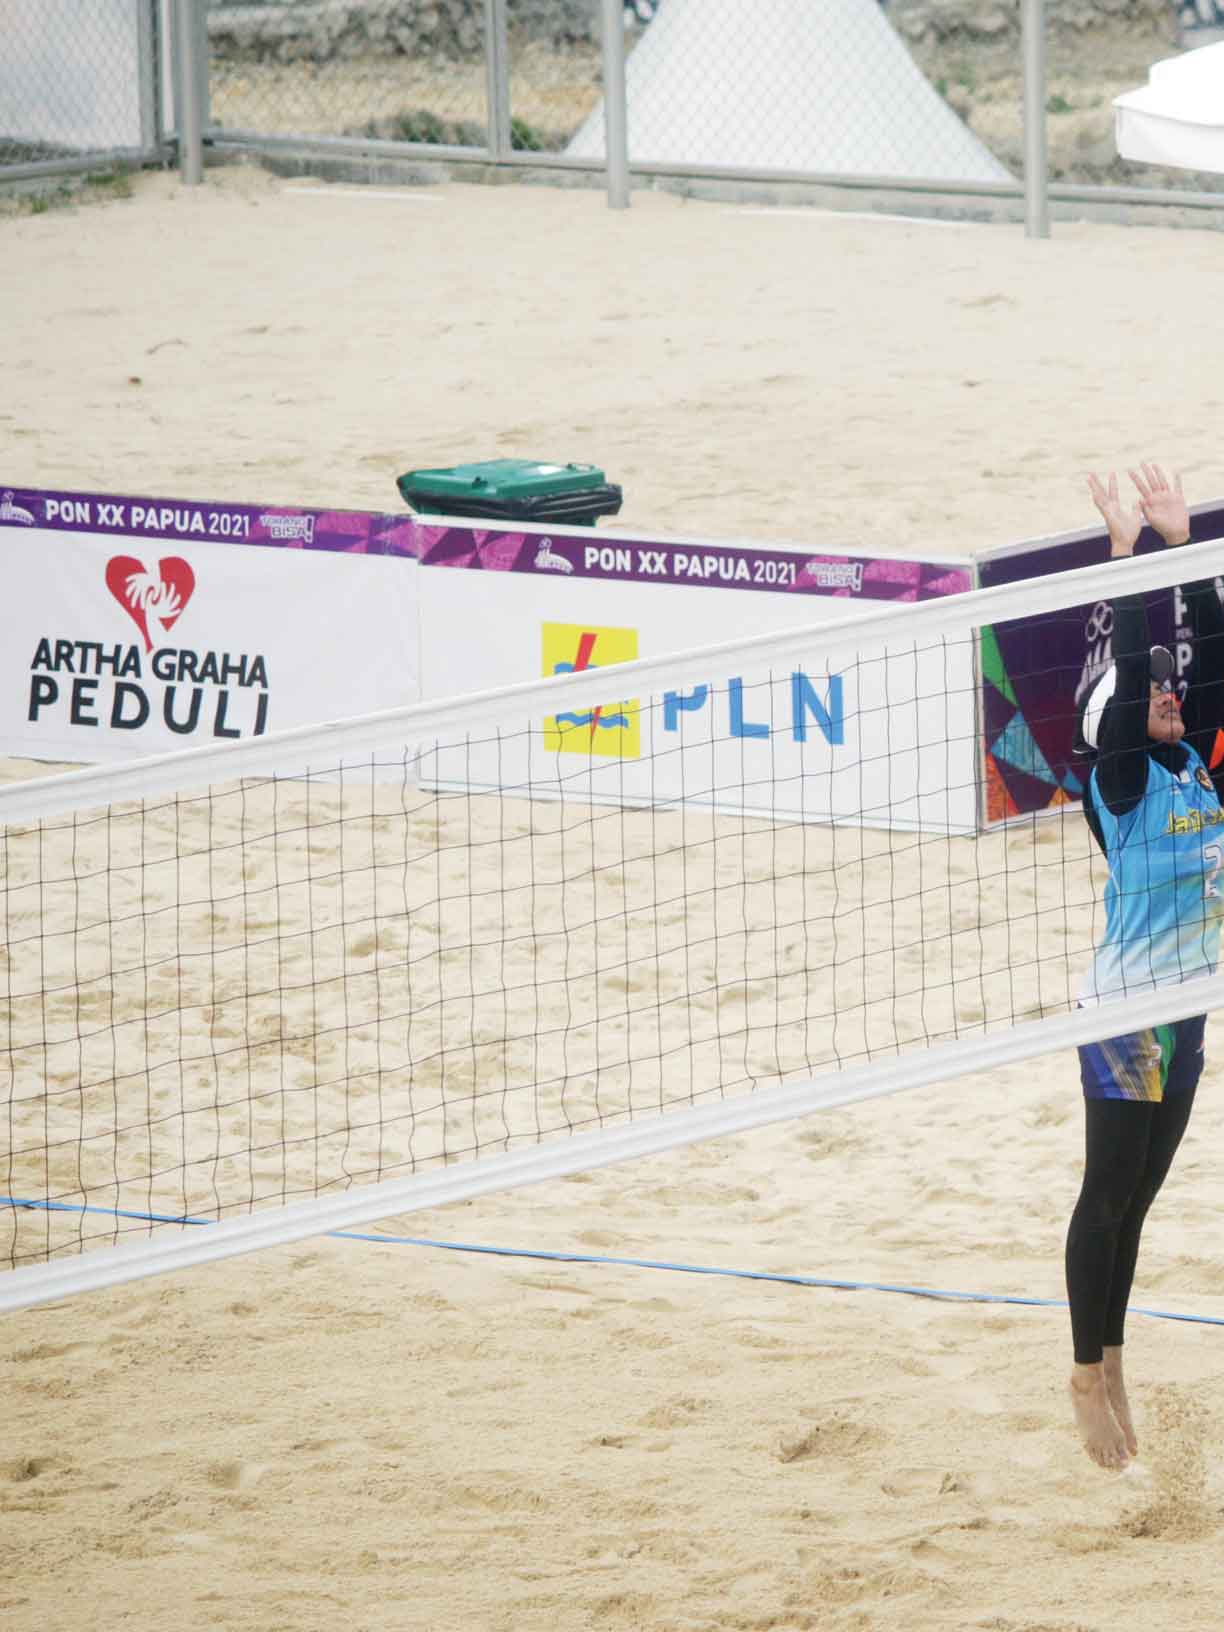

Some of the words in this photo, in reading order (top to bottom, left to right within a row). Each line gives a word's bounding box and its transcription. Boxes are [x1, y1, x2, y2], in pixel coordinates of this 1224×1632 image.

[46, 499, 91, 524] PON
[97, 502, 125, 527] XX
[130, 505, 206, 534] PAPUA
[209, 513, 250, 537] 2021
[584, 546, 631, 572] PON
[637, 550, 667, 575] XX
[673, 552, 751, 582] PAPUA
[753, 560, 796, 585] 2021
[31, 637, 142, 678] ARTHA
[151, 648, 269, 689] GRAHA
[27, 674, 270, 739] PEDULI
[663, 671, 845, 746] PLN
